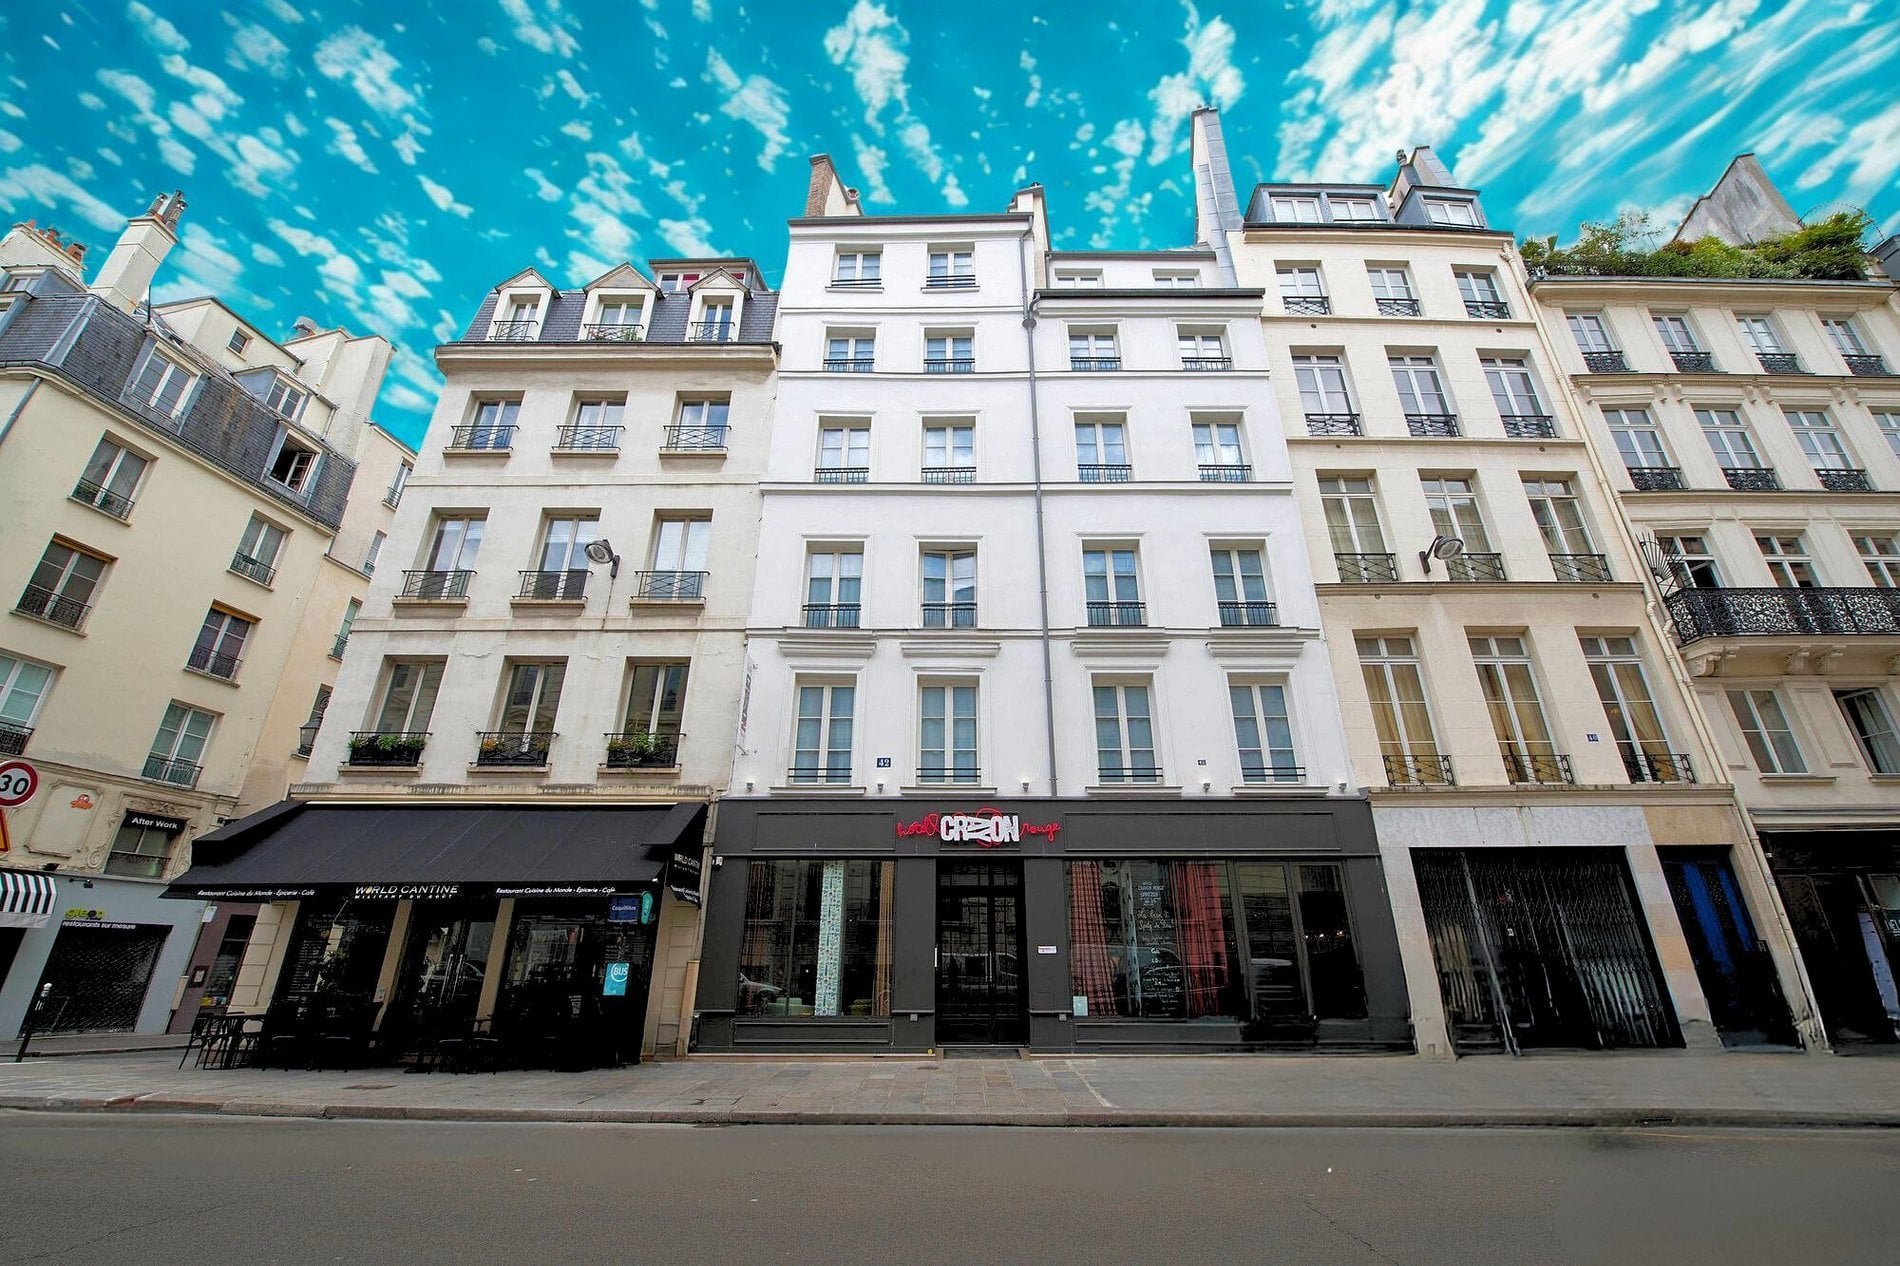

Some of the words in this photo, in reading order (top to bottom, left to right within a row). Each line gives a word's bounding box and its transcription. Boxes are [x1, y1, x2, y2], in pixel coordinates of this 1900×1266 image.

[878, 758, 890, 767] 42
[0, 774, 29, 796] 30
[131, 816, 154, 826] After
[155, 819, 178, 829] Work
[1020, 822, 1061, 842] rouge
[355, 886, 398, 894] WORLD
[400, 886, 460, 894] CANTINE
[613, 966, 628, 975] BUS
